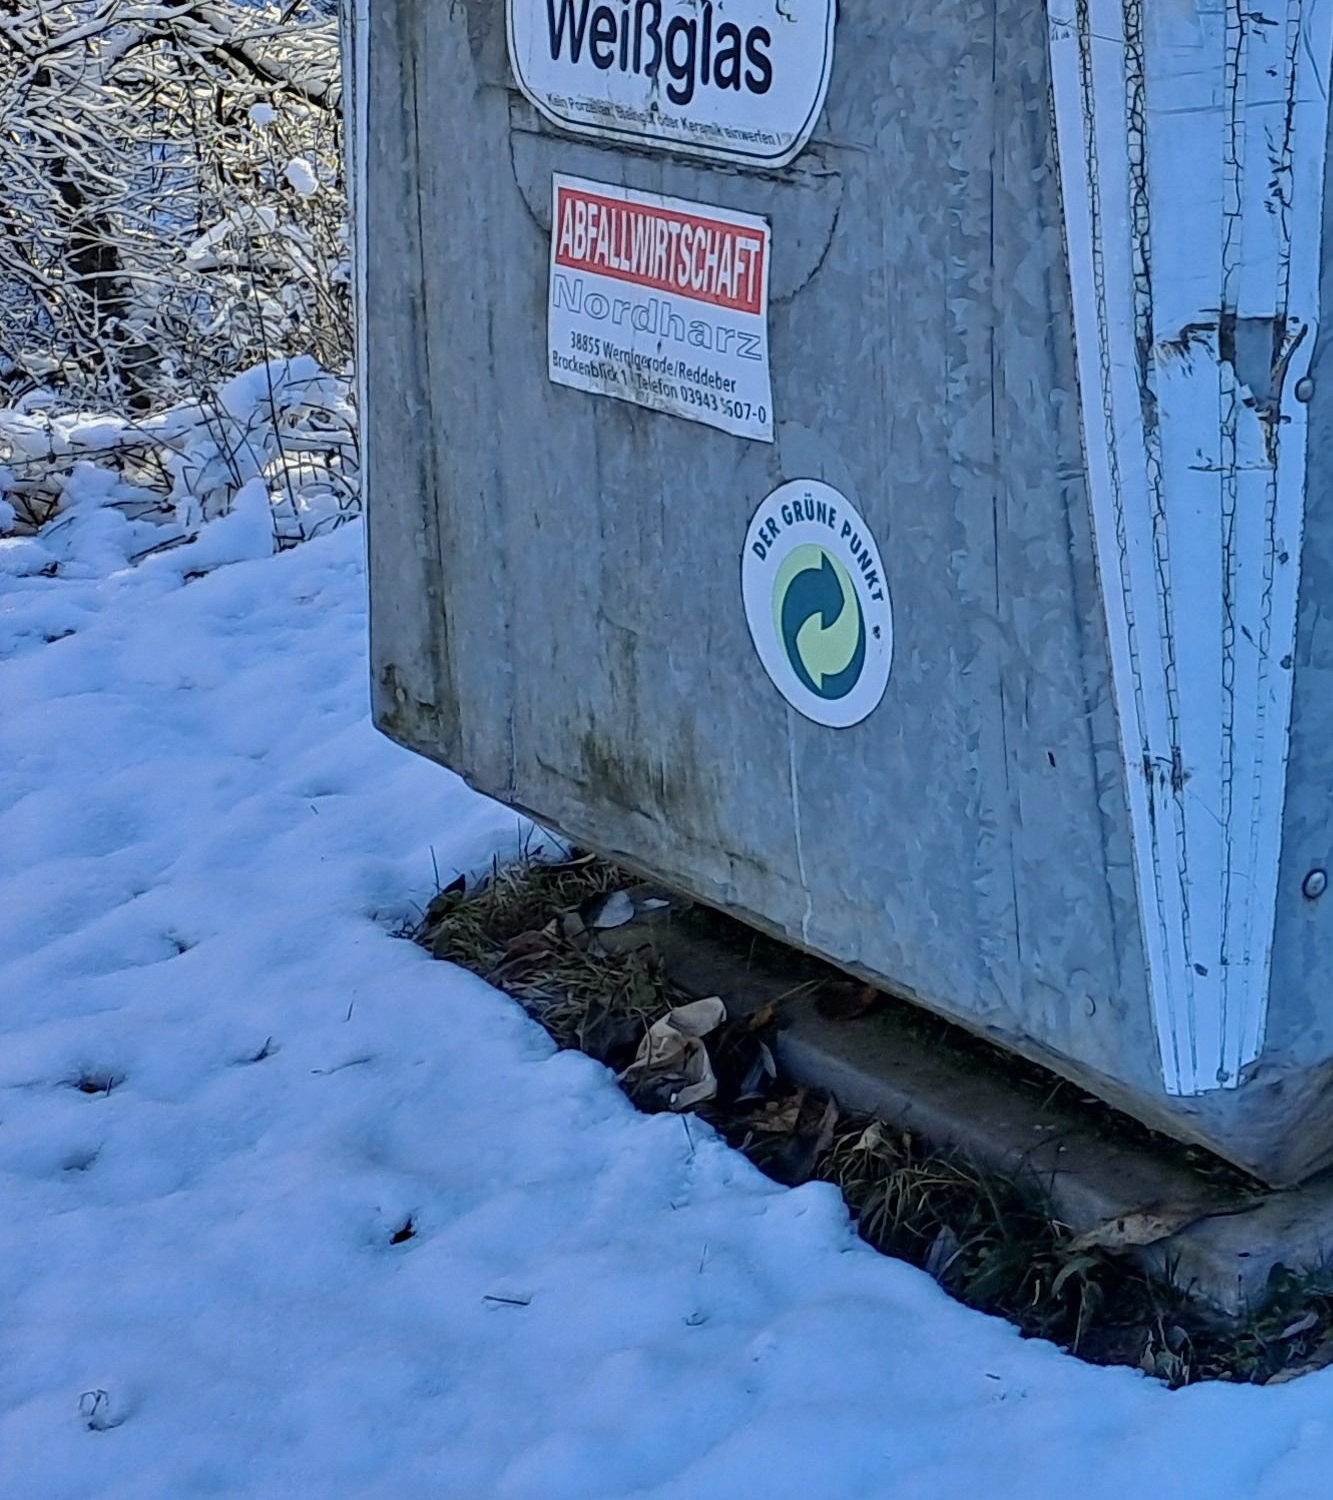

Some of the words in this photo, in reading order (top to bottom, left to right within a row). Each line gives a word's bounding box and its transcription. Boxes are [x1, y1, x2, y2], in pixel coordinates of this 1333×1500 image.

[658, 113, 680, 129] oder
[558, 197, 761, 303] ABFALLWIRTSCHAFT
[552, 273, 763, 361] Nordharz
[552, 350, 618, 384] Brockenblick
[636, 373, 679, 400] Telefon
[680, 386, 718, 411] 03943
[570, 331, 600, 357] 38855
[602, 340, 737, 394] Wernigerode/Reddeber
[752, 517, 782, 562] DER
[781, 492, 837, 530] GRÜNE
[840, 519, 884, 602] PUNKT
